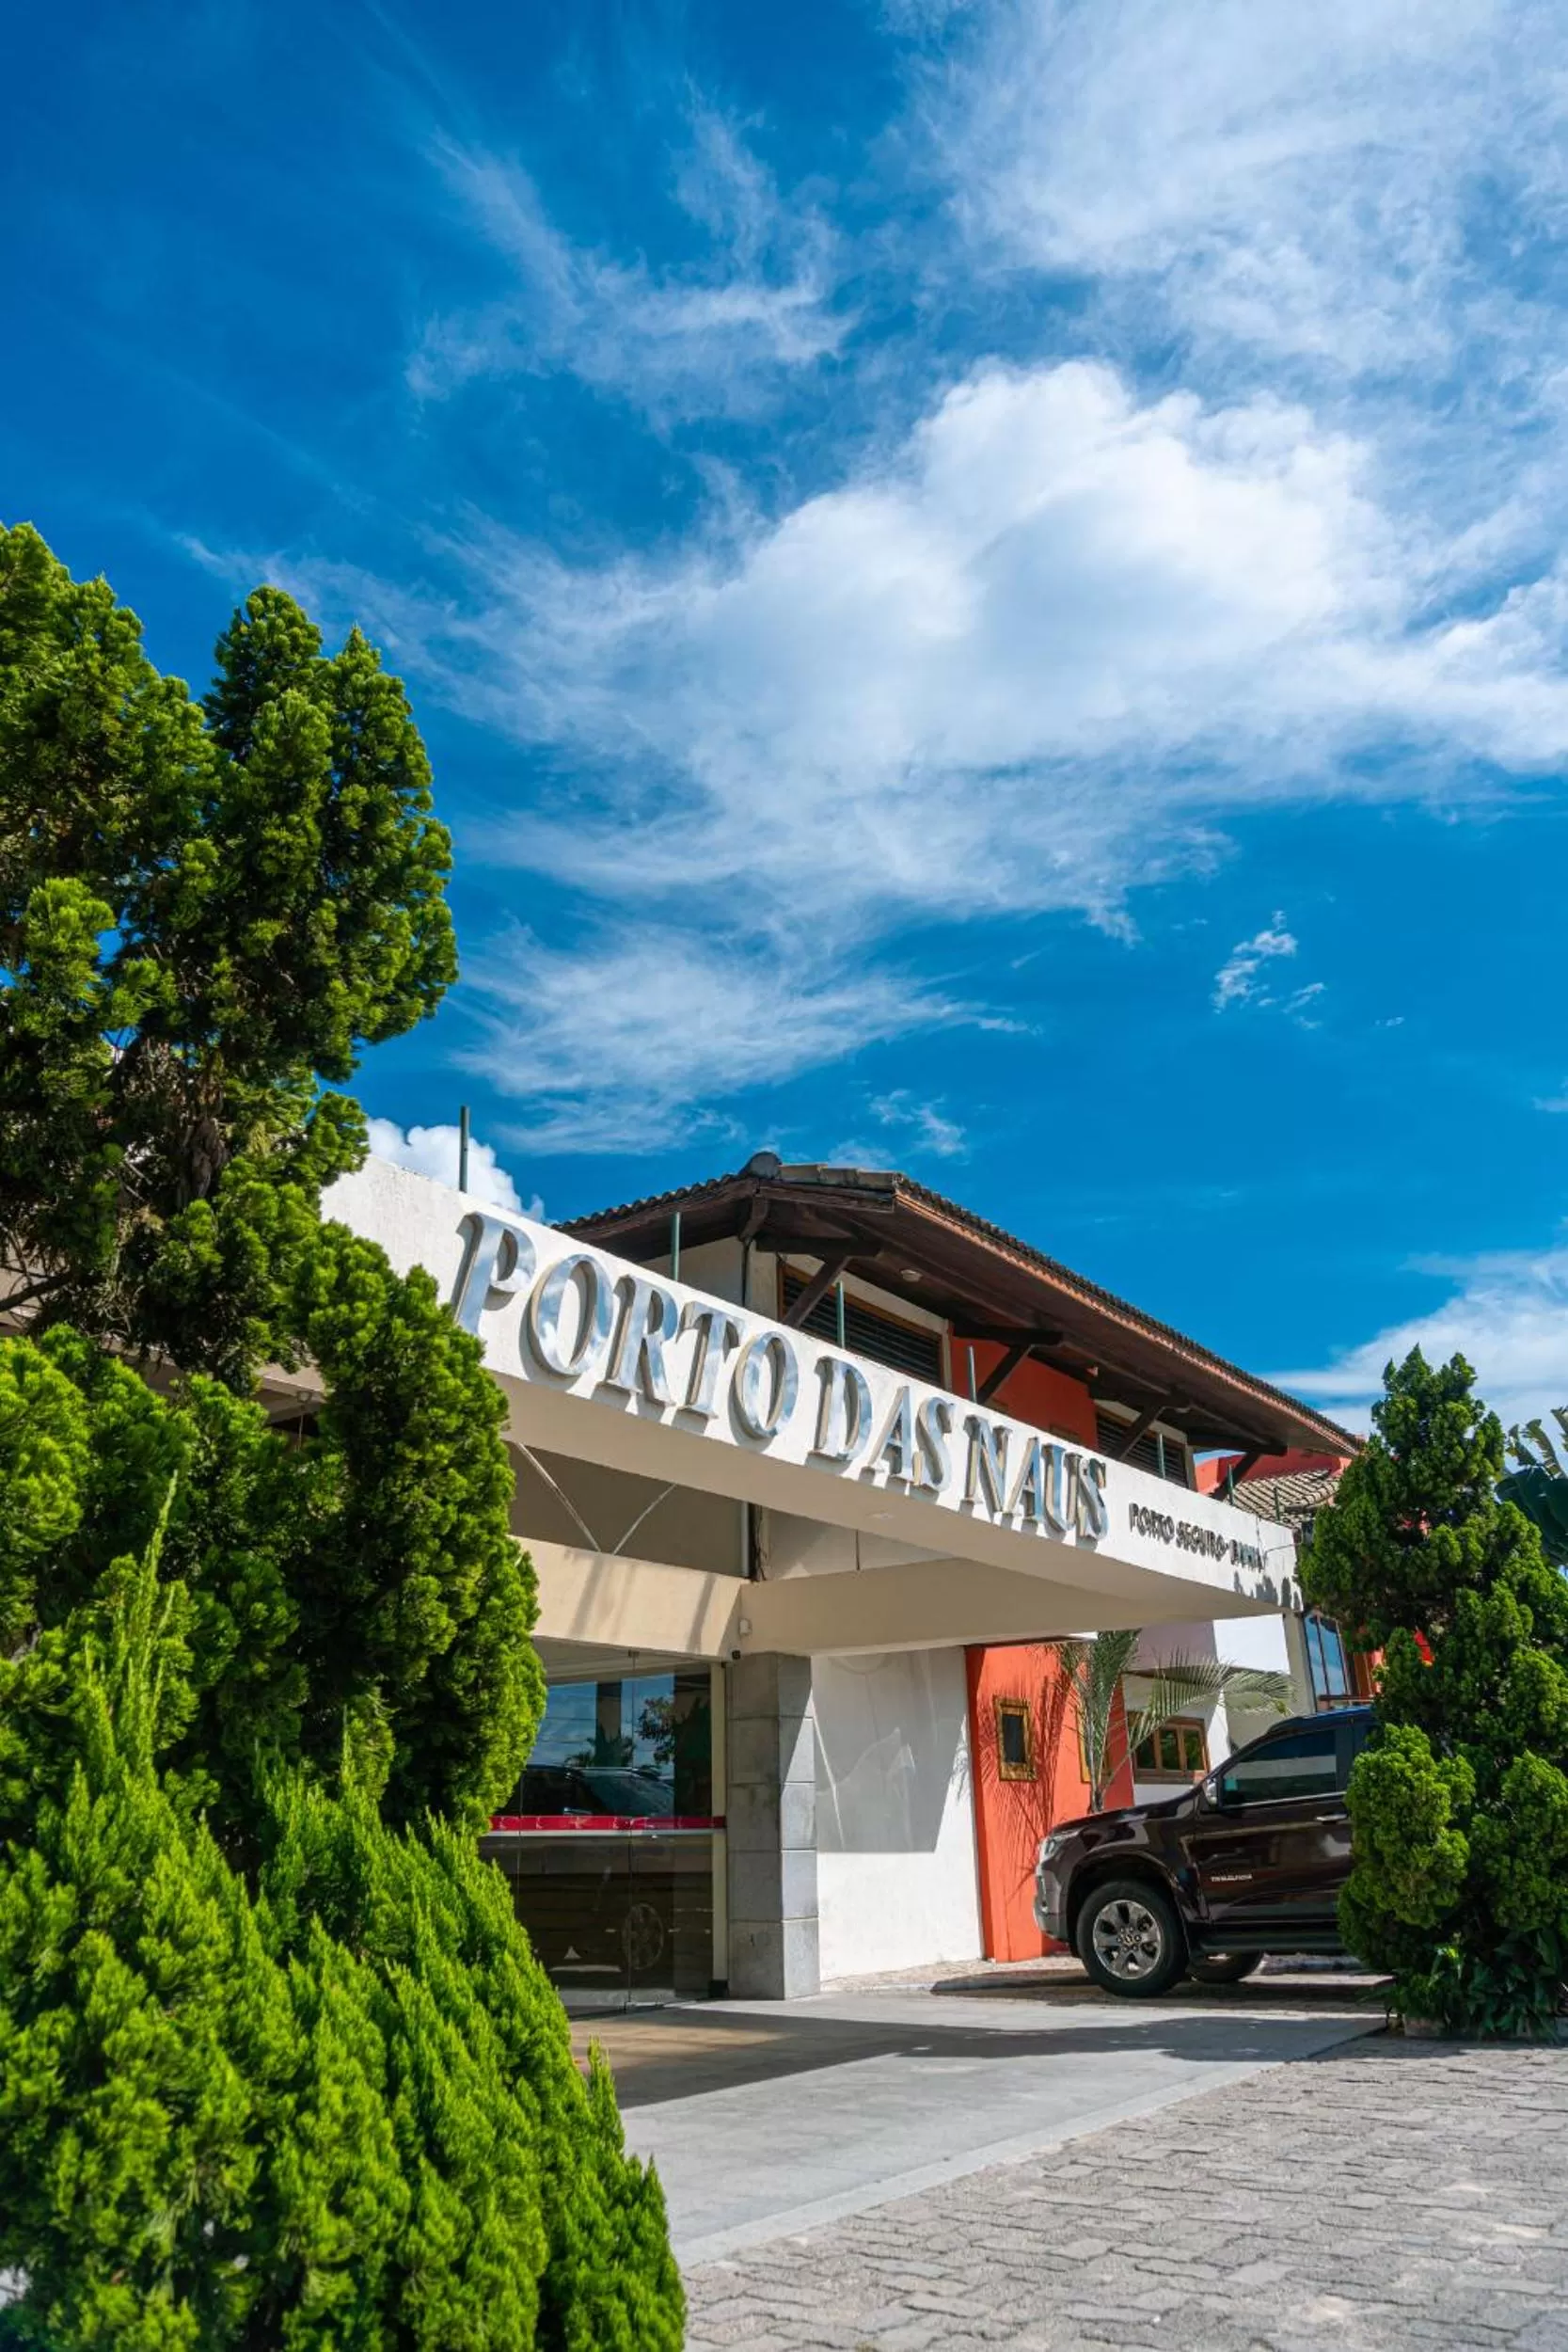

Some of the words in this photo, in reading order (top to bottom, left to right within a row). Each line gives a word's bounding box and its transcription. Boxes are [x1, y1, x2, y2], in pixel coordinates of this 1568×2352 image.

[451, 1212, 799, 1438] PORTO
[806, 1355, 954, 1493] DAS
[962, 1414, 1109, 1541] NAUS
[1129, 1502, 1175, 1545] PORTO
